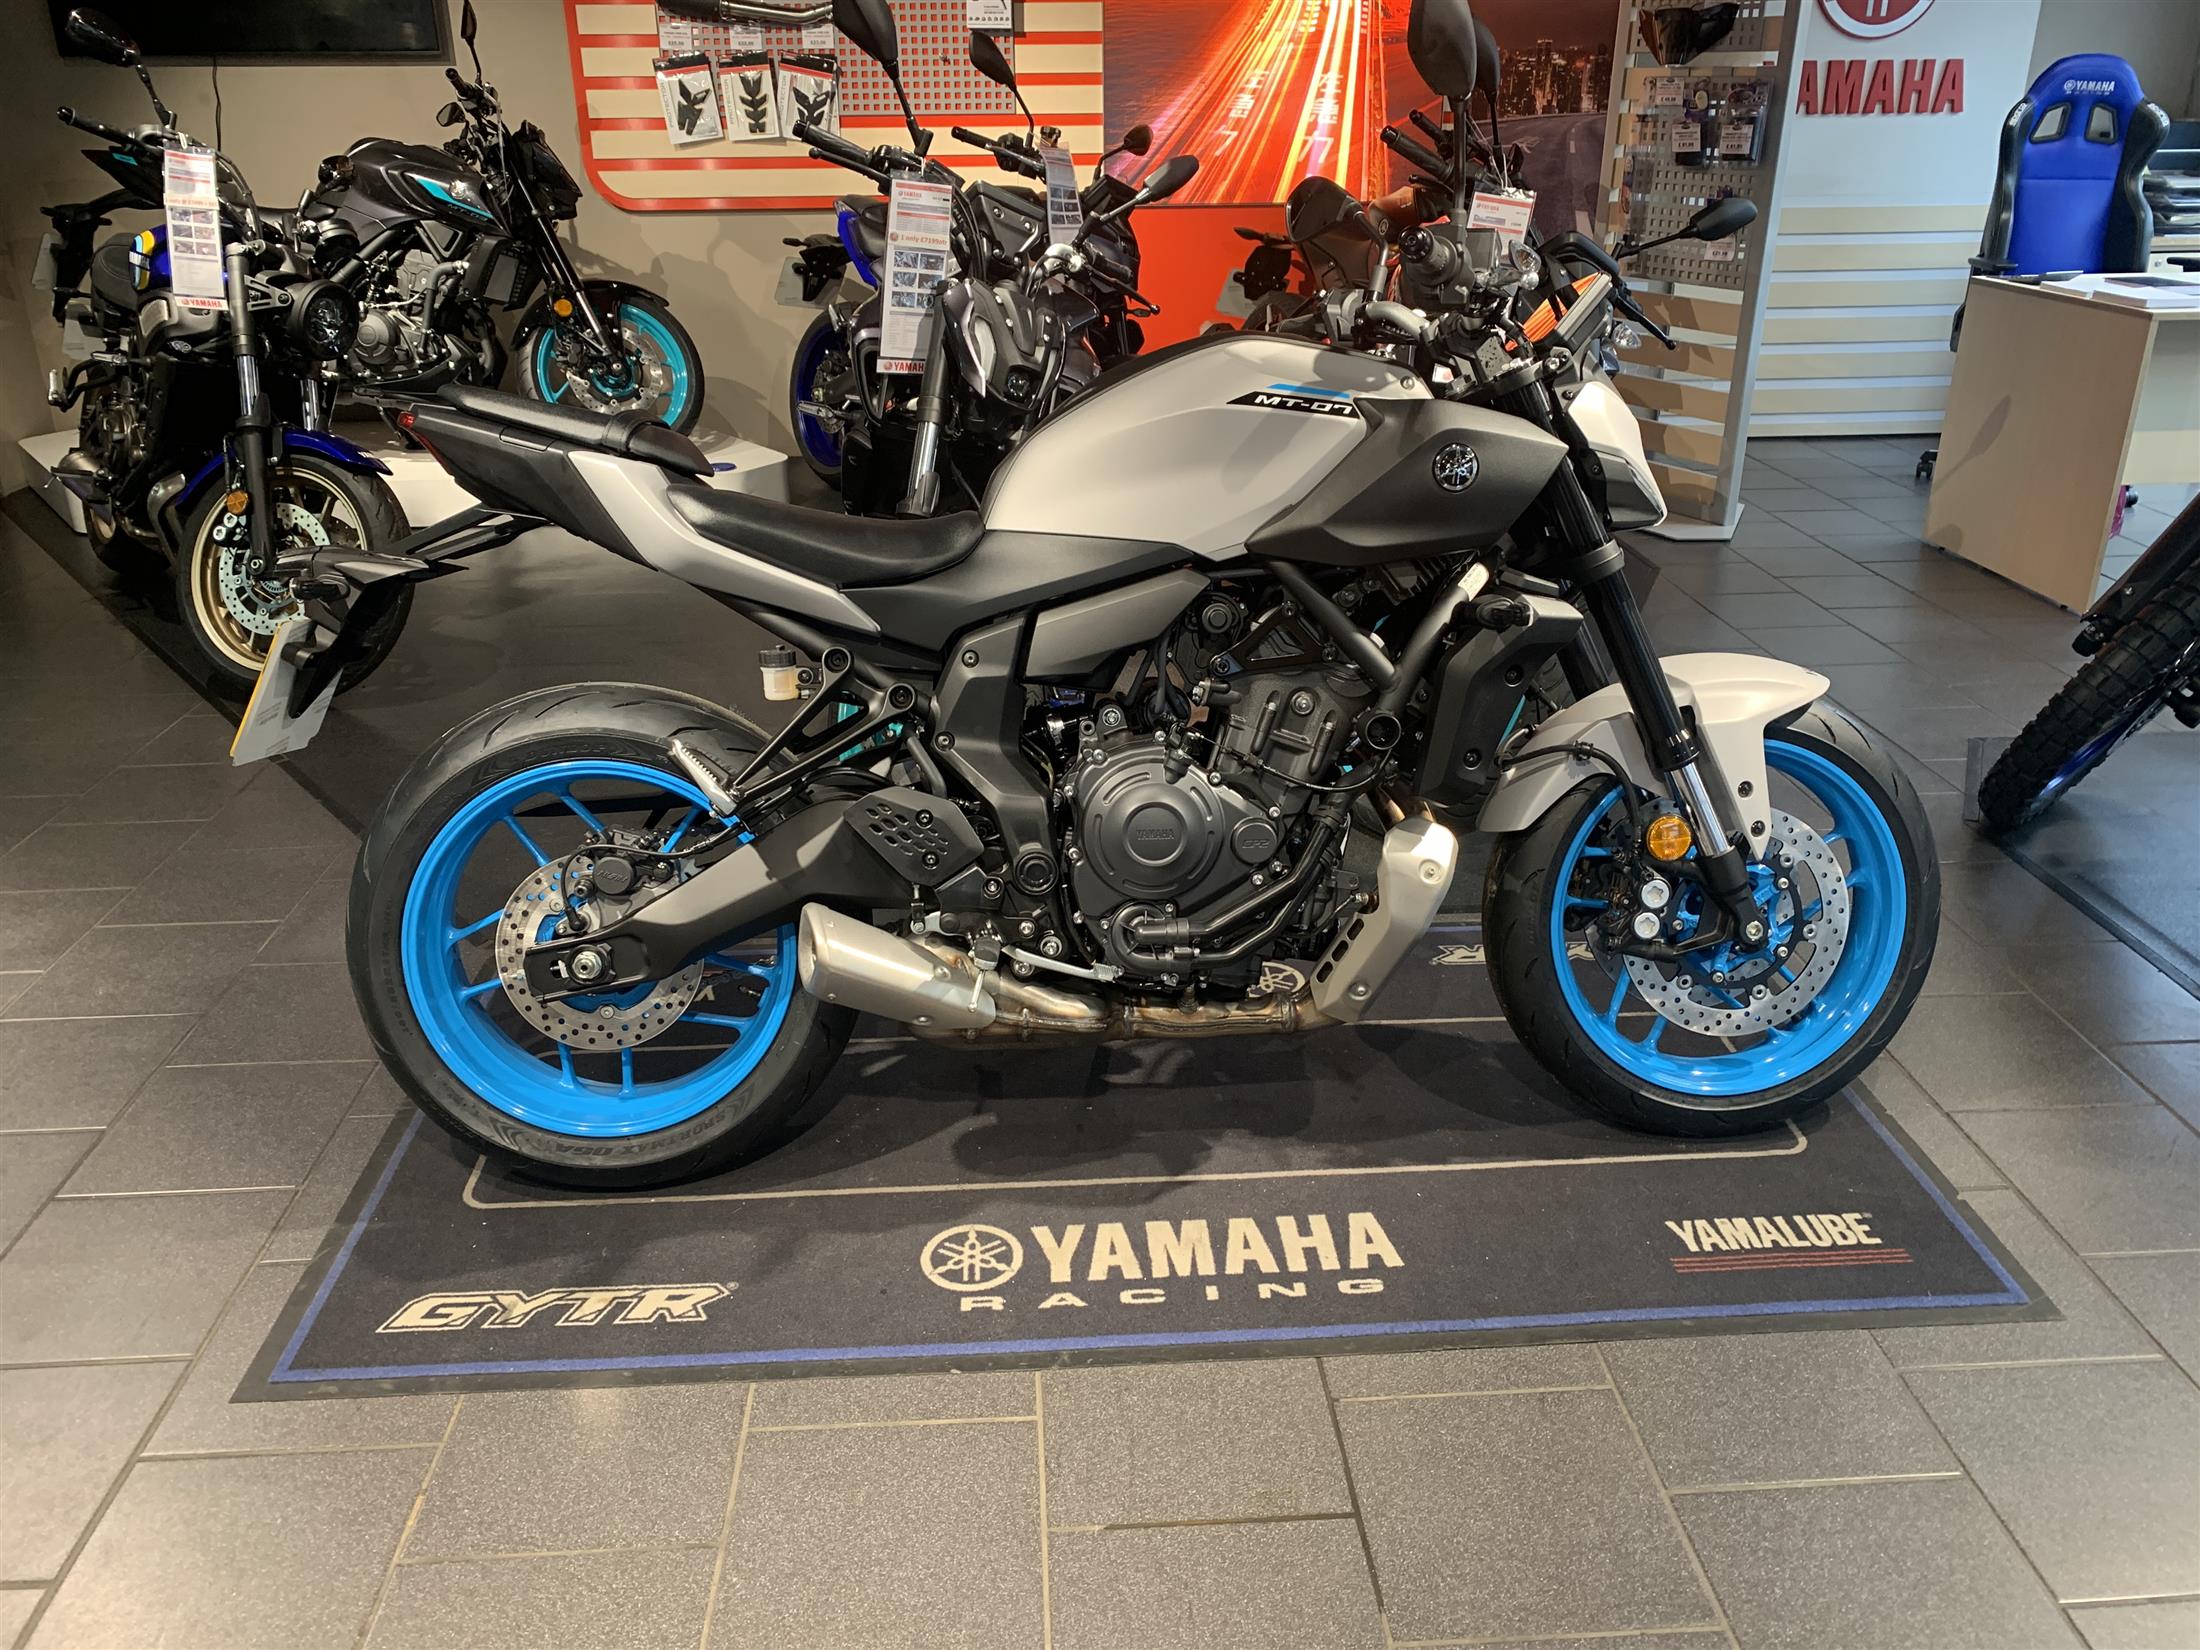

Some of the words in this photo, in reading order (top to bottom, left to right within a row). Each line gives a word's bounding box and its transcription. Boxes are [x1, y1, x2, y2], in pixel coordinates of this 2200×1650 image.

[1796, 59, 1964, 115] AMAHA
[2076, 80, 2116, 92] YAMAHA
[190, 299, 223, 309] YAMAHA
[894, 361, 925, 372] YAMAH
[1254, 394, 1353, 415] MT-07
[1030, 1211, 1405, 1284] YAMAHA
[1664, 1212, 1883, 1252] YAMALUBE
[376, 1283, 731, 1334] GYTR
[959, 1277, 1386, 1312] RACING
